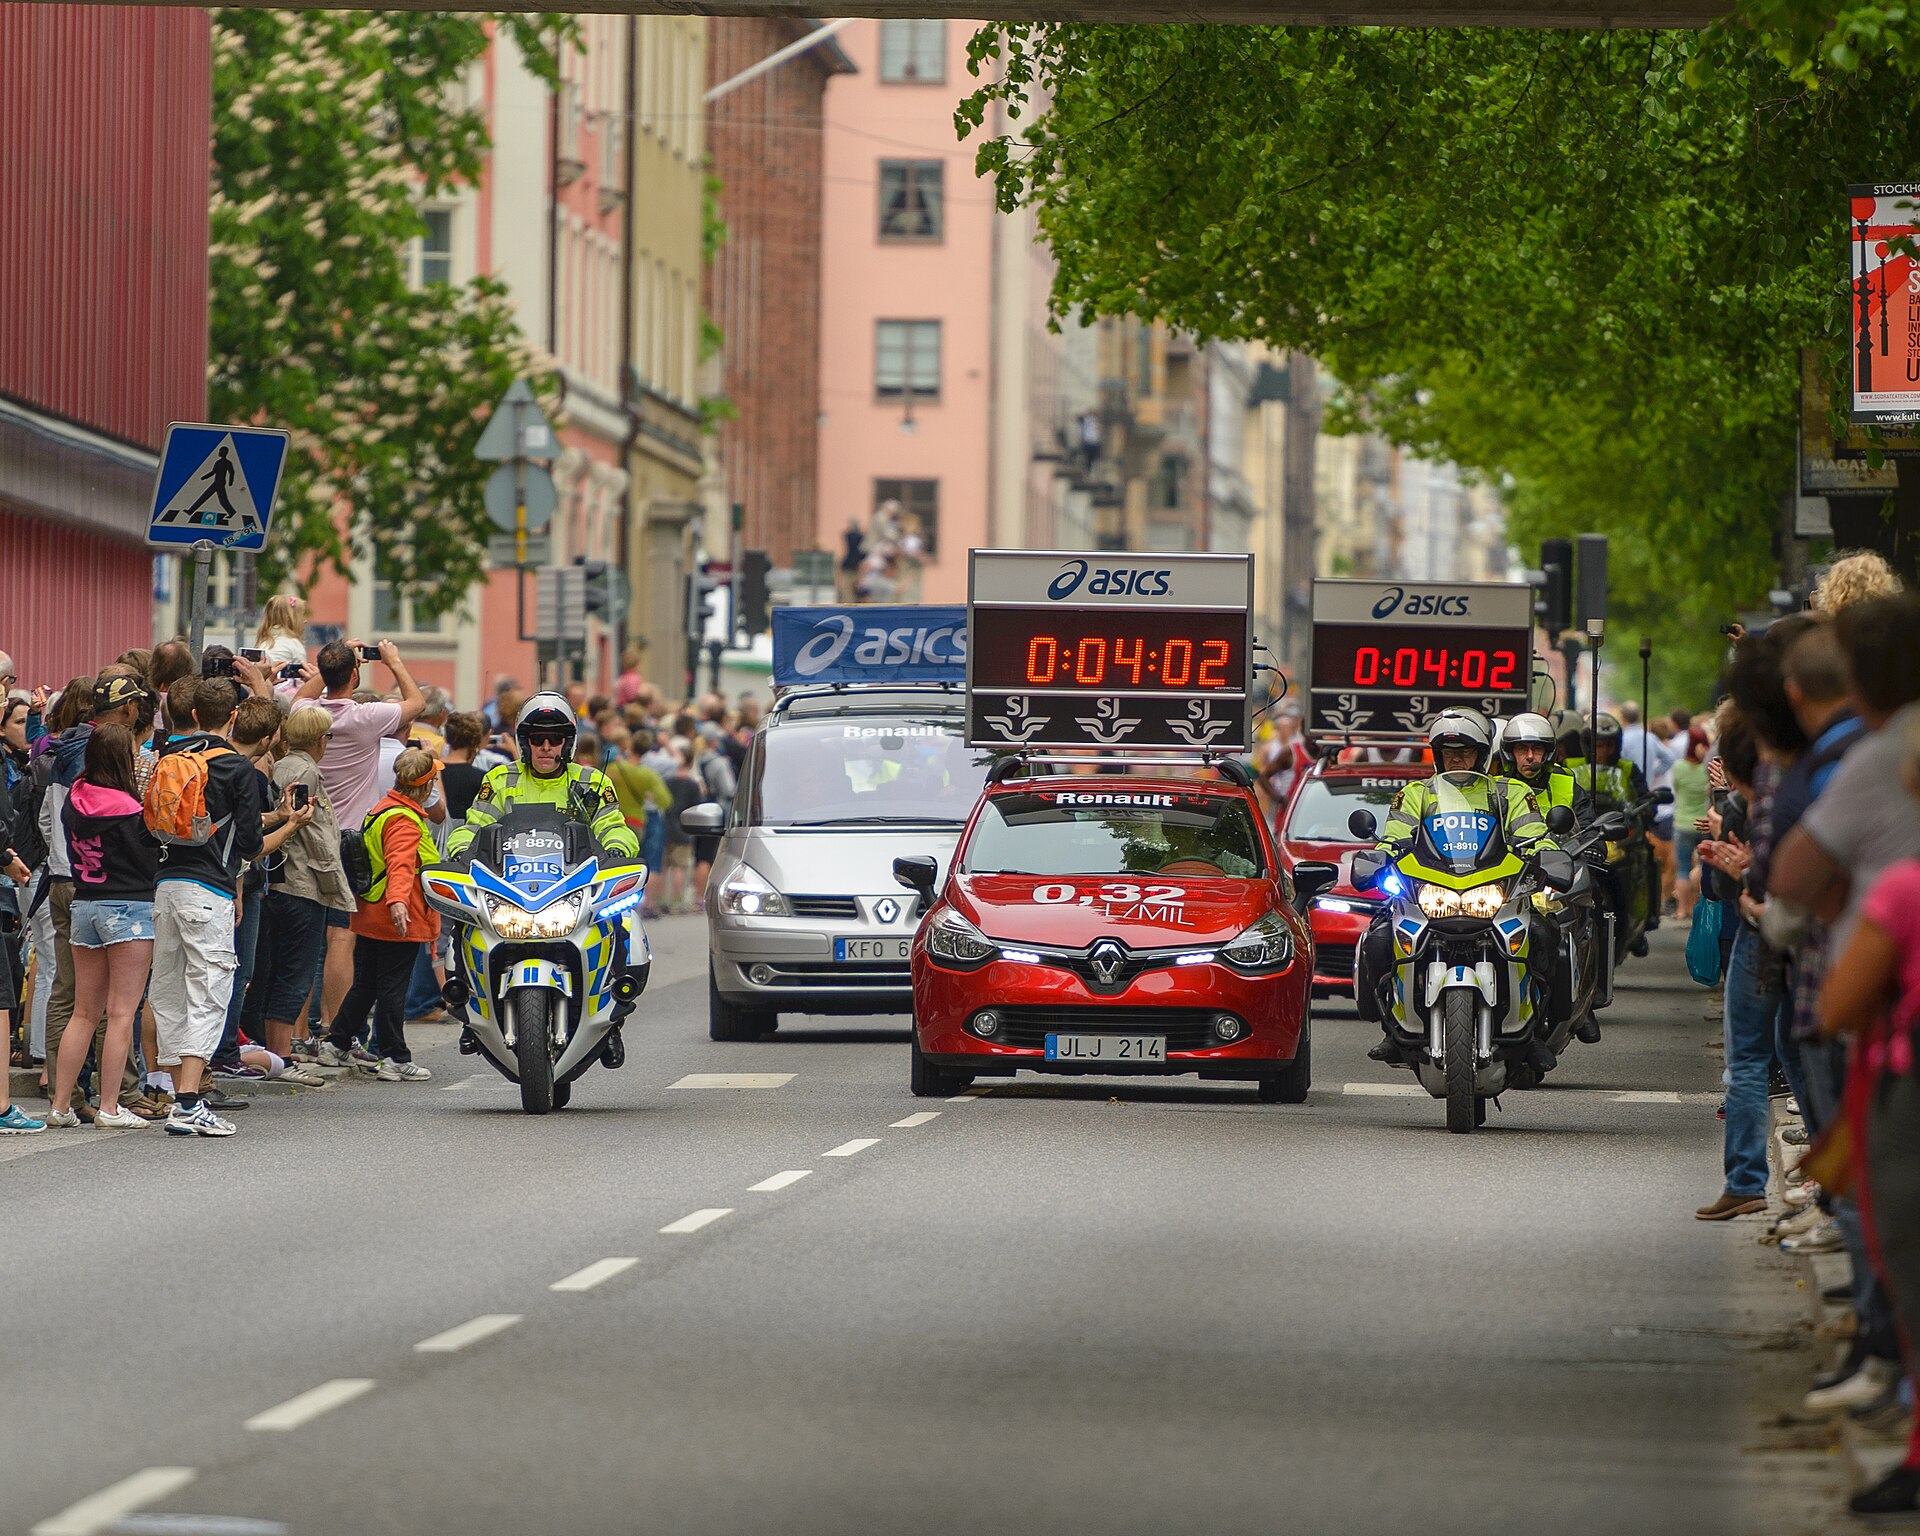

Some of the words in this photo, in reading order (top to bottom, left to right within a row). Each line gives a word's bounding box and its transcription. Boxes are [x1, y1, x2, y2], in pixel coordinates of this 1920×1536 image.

[1088, 569, 1171, 596] asics
[1404, 595, 1469, 616] asics
[854, 627, 967, 665] asics
[1026, 636, 1230, 687] 0:04:02
[1354, 647, 1516, 689] 0:04:02
[1006, 695, 1030, 718] SJ
[1096, 698, 1120, 719] SJ
[1187, 699, 1211, 721] SJ
[1338, 694, 1357, 713] SJ
[1410, 696, 1429, 714] SJ
[1481, 698, 1500, 716] SJ
[843, 725, 946, 738] Renault
[1056, 792, 1174, 808] Renault
[529, 828, 537, 838] 1
[1432, 815, 1489, 832] POLIS
[502, 840, 520, 851] 31
[525, 838, 564, 850] 8870
[1458, 831, 1465, 841] 1
[1442, 842, 1479, 852] 31-8910
[508, 862, 560, 877] POLIS
[1032, 883, 1186, 907] 0,32
[1105, 903, 1195, 926] L/MIL
[848, 941, 882, 958] KFO
[898, 941, 909, 957] 6
[1061, 1038, 1101, 1057] JLJ
[1119, 1039, 1160, 1058] 214
